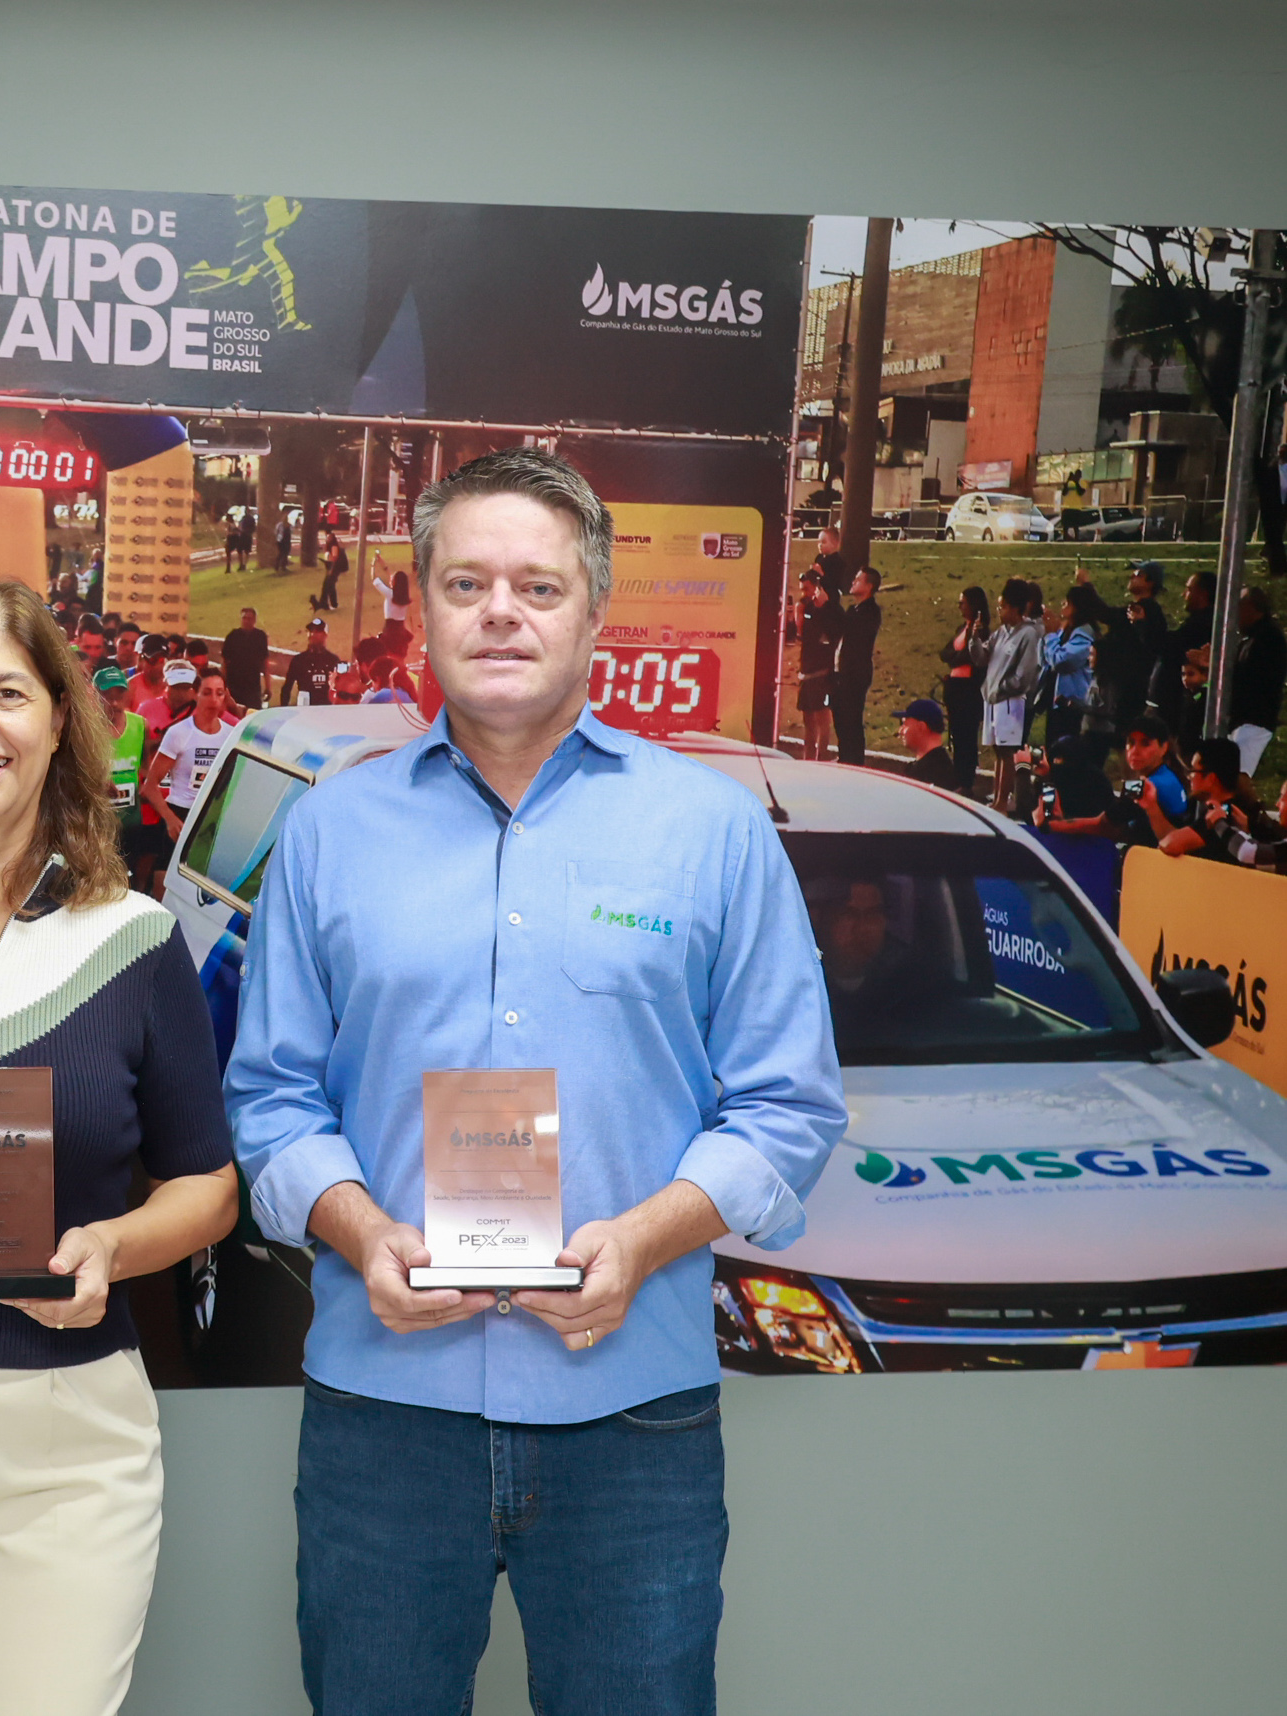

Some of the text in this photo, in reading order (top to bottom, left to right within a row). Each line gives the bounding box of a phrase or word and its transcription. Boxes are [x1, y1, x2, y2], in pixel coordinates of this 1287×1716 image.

[131, 208, 177, 239] DE
[616, 279, 764, 326] MSGÁS
[213, 309, 254, 325] MATO
[213, 326, 270, 342] GROSSO
[580, 318, 762, 339] Companhia de Gás do Estado de Mato Grosso do Sul
[212, 342, 263, 358] DO SUL
[212, 358, 263, 374] BRASIL
[614, 579, 728, 597] UNDESPORTE
[607, 911, 673, 936] MSGÁS
[983, 903, 1009, 926] ÁGUAS
[465, 1129, 532, 1147] MSGÁS
[930, 1143, 1271, 1185] MSGÁS
[458, 1227, 505, 1253] PEX
